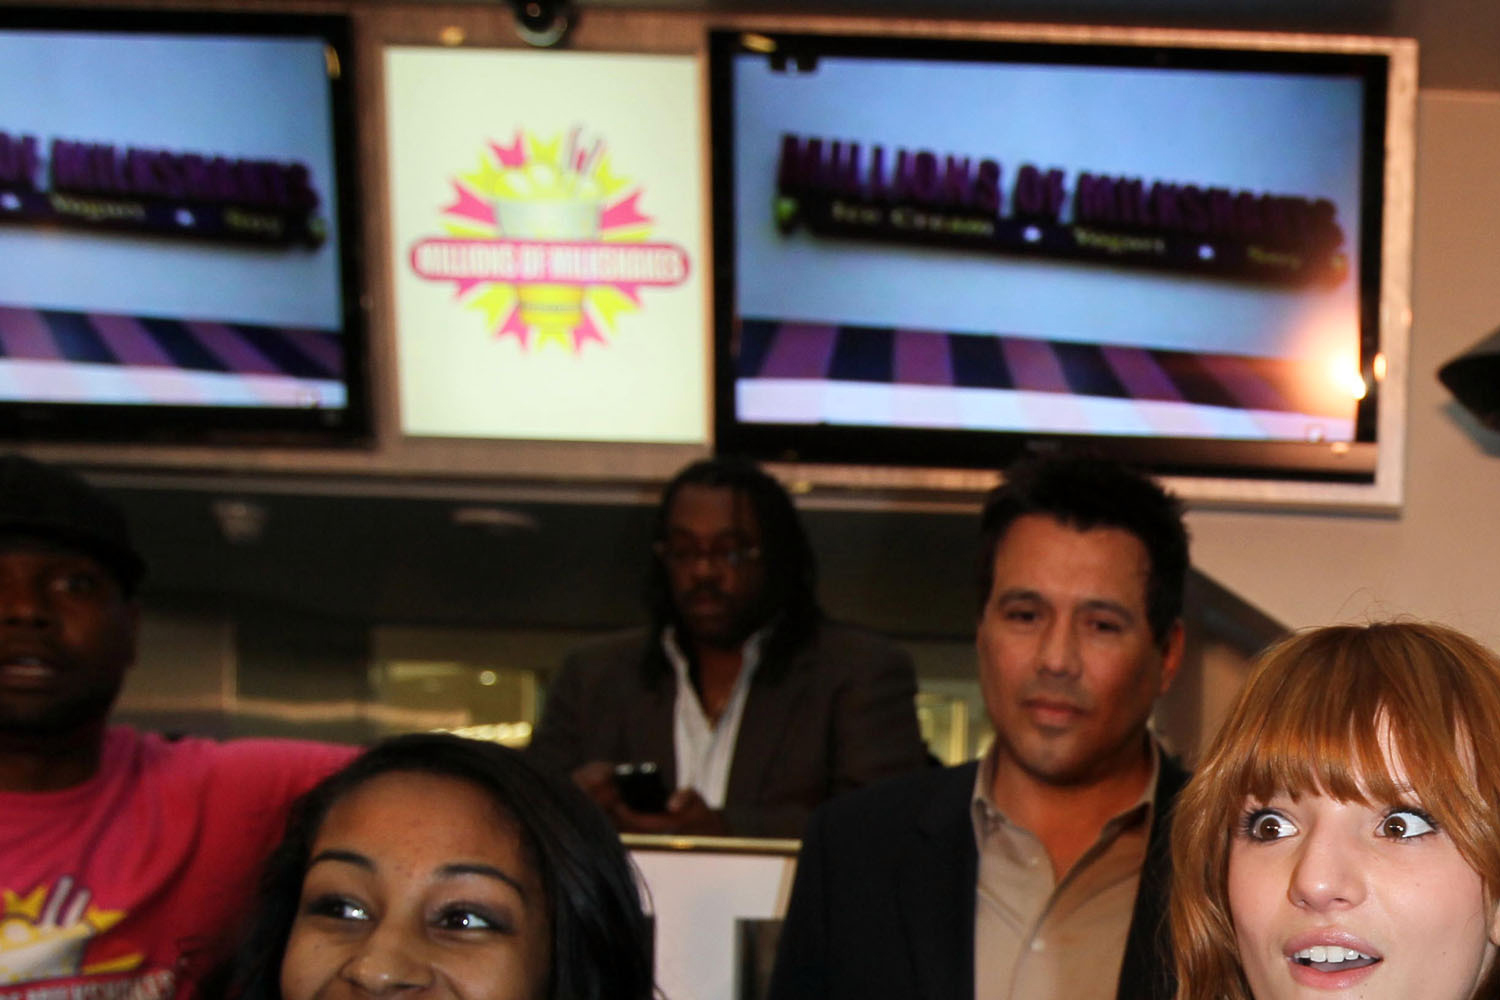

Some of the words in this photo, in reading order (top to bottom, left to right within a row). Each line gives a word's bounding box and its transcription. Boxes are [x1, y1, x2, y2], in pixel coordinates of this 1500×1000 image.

[418, 244, 514, 276] MILLIONS
[521, 246, 544, 278] OF
[550, 248, 682, 282] MILKSHAKES
